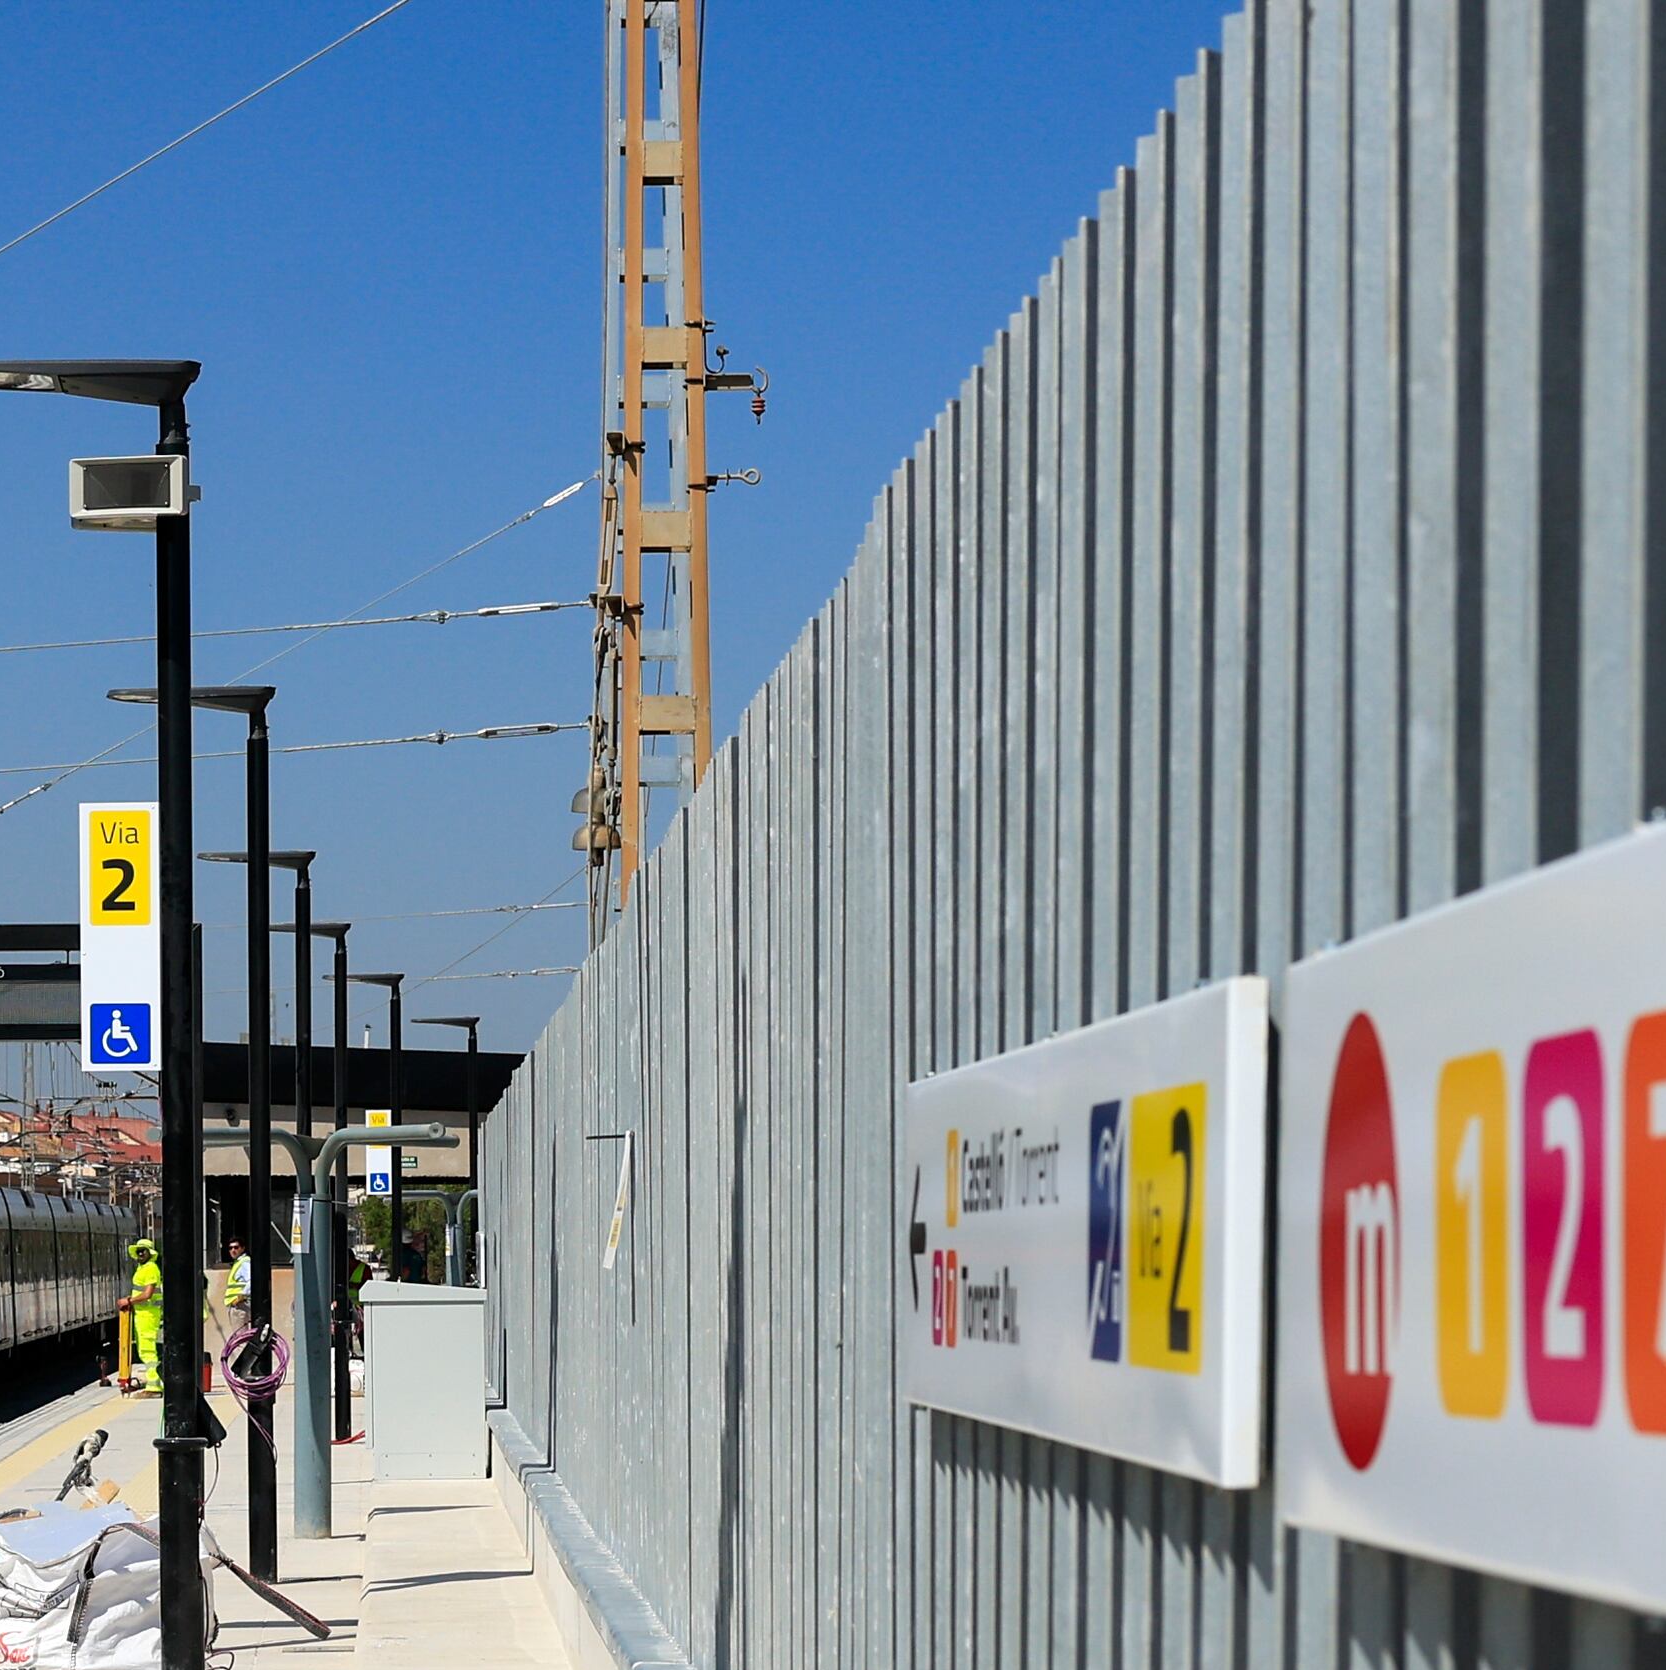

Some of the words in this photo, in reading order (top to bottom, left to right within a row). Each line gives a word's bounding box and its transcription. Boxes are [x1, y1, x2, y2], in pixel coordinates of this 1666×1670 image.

[101, 822, 140, 844] Via
[101, 859, 136, 911] 2
[1167, 1107, 1193, 1354] 2
[1345, 1180, 1395, 1377] m
[1454, 1114, 1483, 1356] 1
[1542, 1094, 1586, 1361] 2
